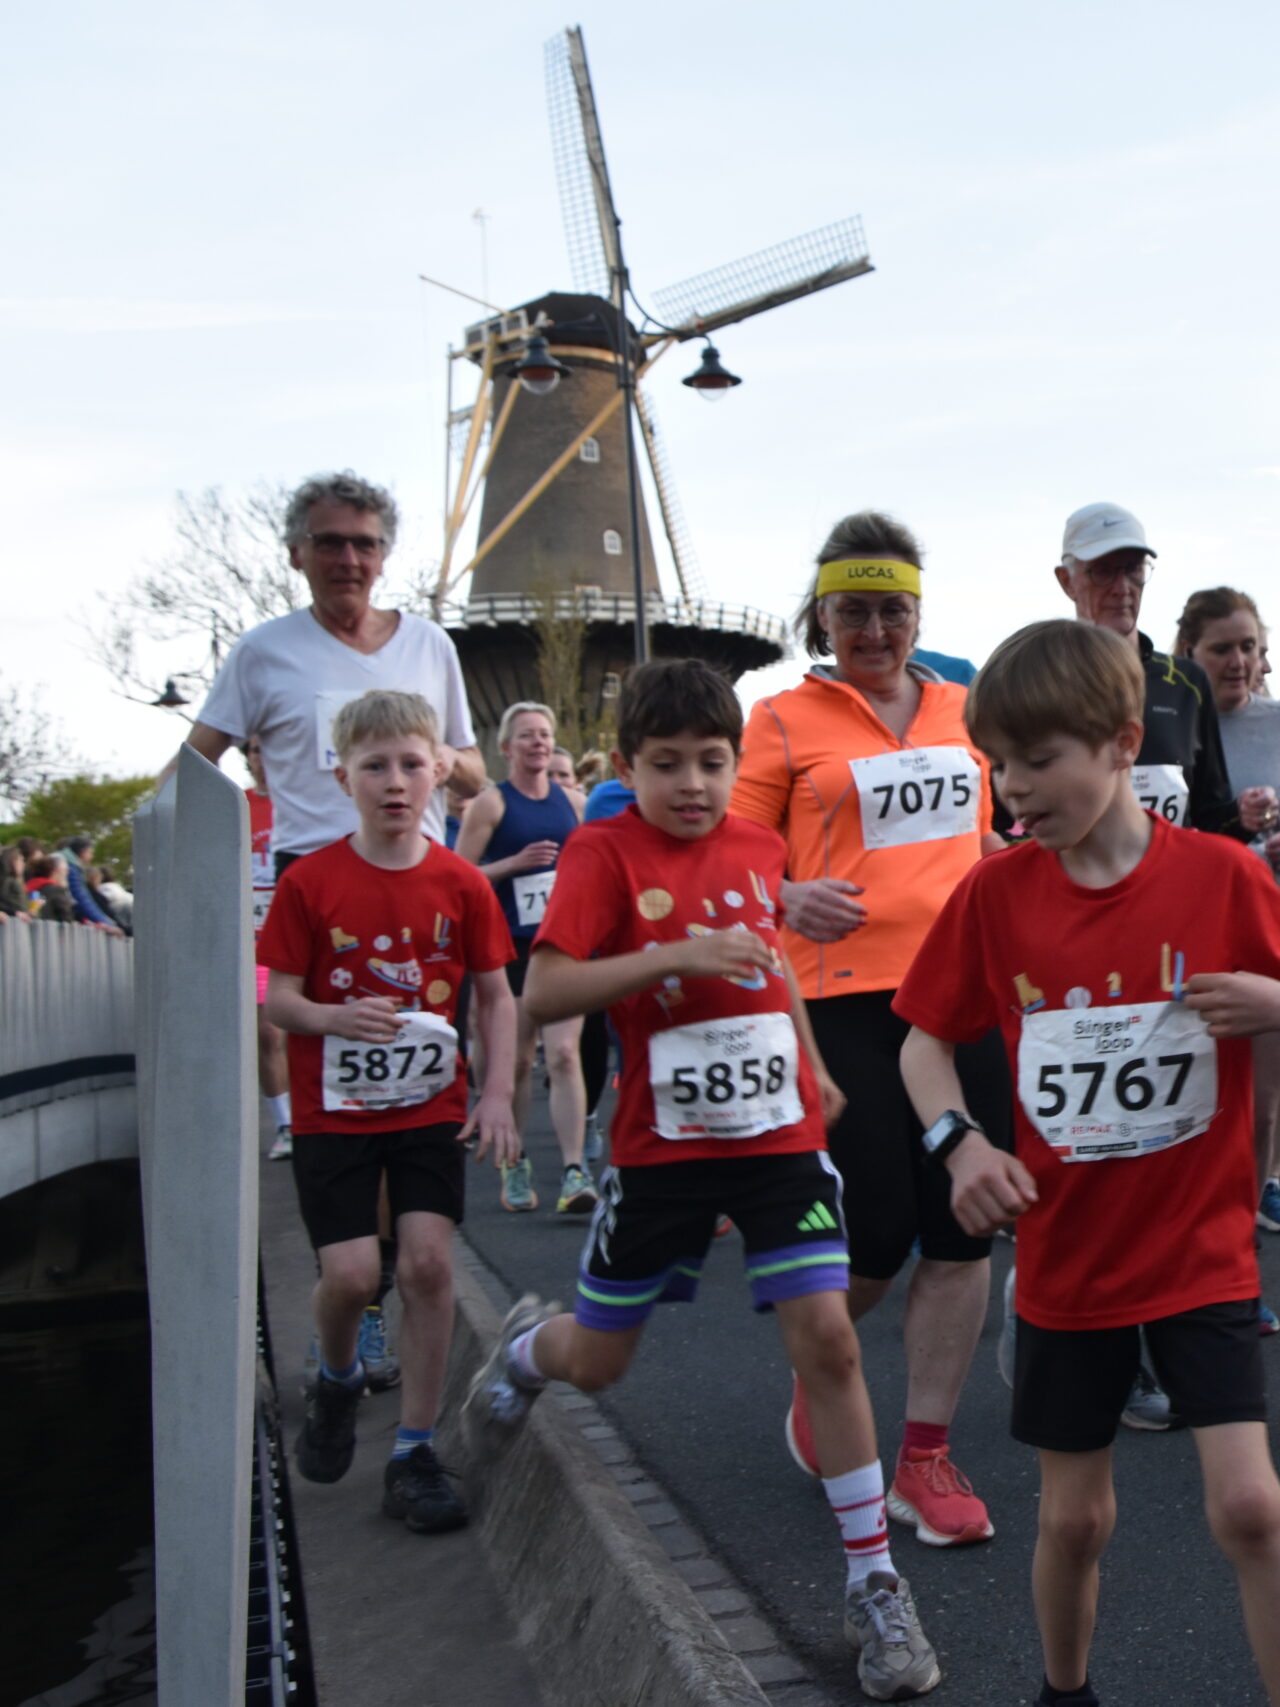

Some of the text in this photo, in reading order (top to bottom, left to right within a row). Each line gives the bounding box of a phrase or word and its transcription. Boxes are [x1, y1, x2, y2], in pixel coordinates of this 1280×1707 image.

[847, 566, 894, 579] LUCAS
[872, 773, 970, 819] 7075
[1139, 795, 1178, 822] 76
[523, 891, 547, 910] 71
[1074, 1016, 1130, 1036] Singel
[1096, 1035, 1134, 1051] loop
[338, 1043, 443, 1083] 5872
[672, 1055, 786, 1105] 5858
[1037, 1053, 1193, 1118] 5767
